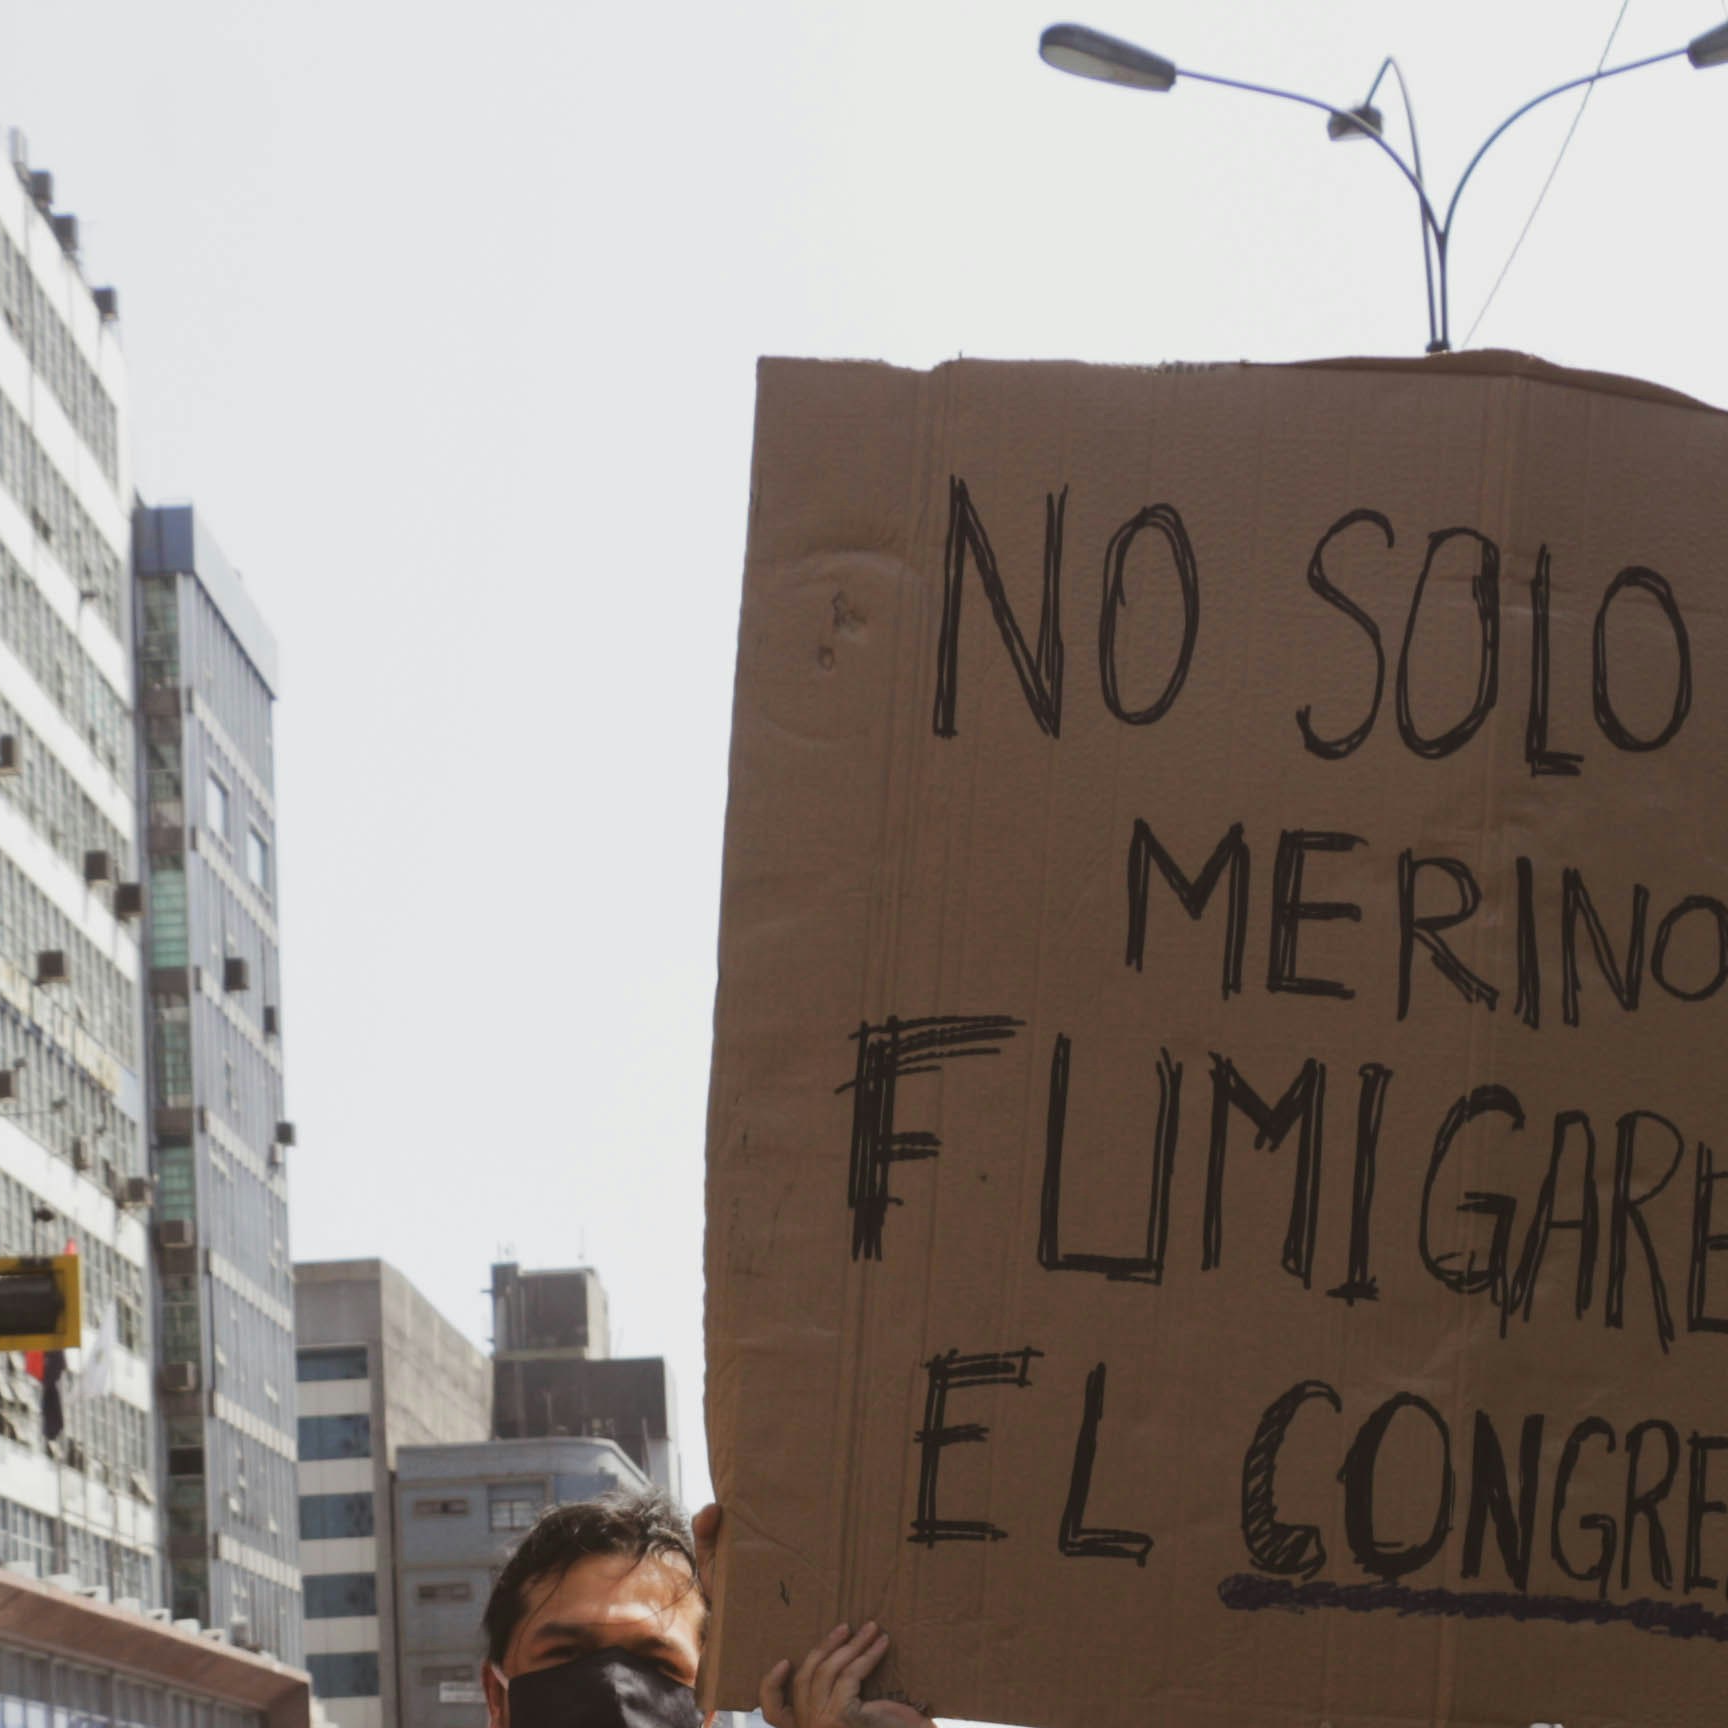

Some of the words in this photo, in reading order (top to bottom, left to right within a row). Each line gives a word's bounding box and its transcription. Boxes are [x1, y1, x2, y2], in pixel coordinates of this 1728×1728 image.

[932, 475, 1200, 740] NO
[1295, 508, 1693, 779] SOLO
[906, 1345, 1156, 1569] EL
